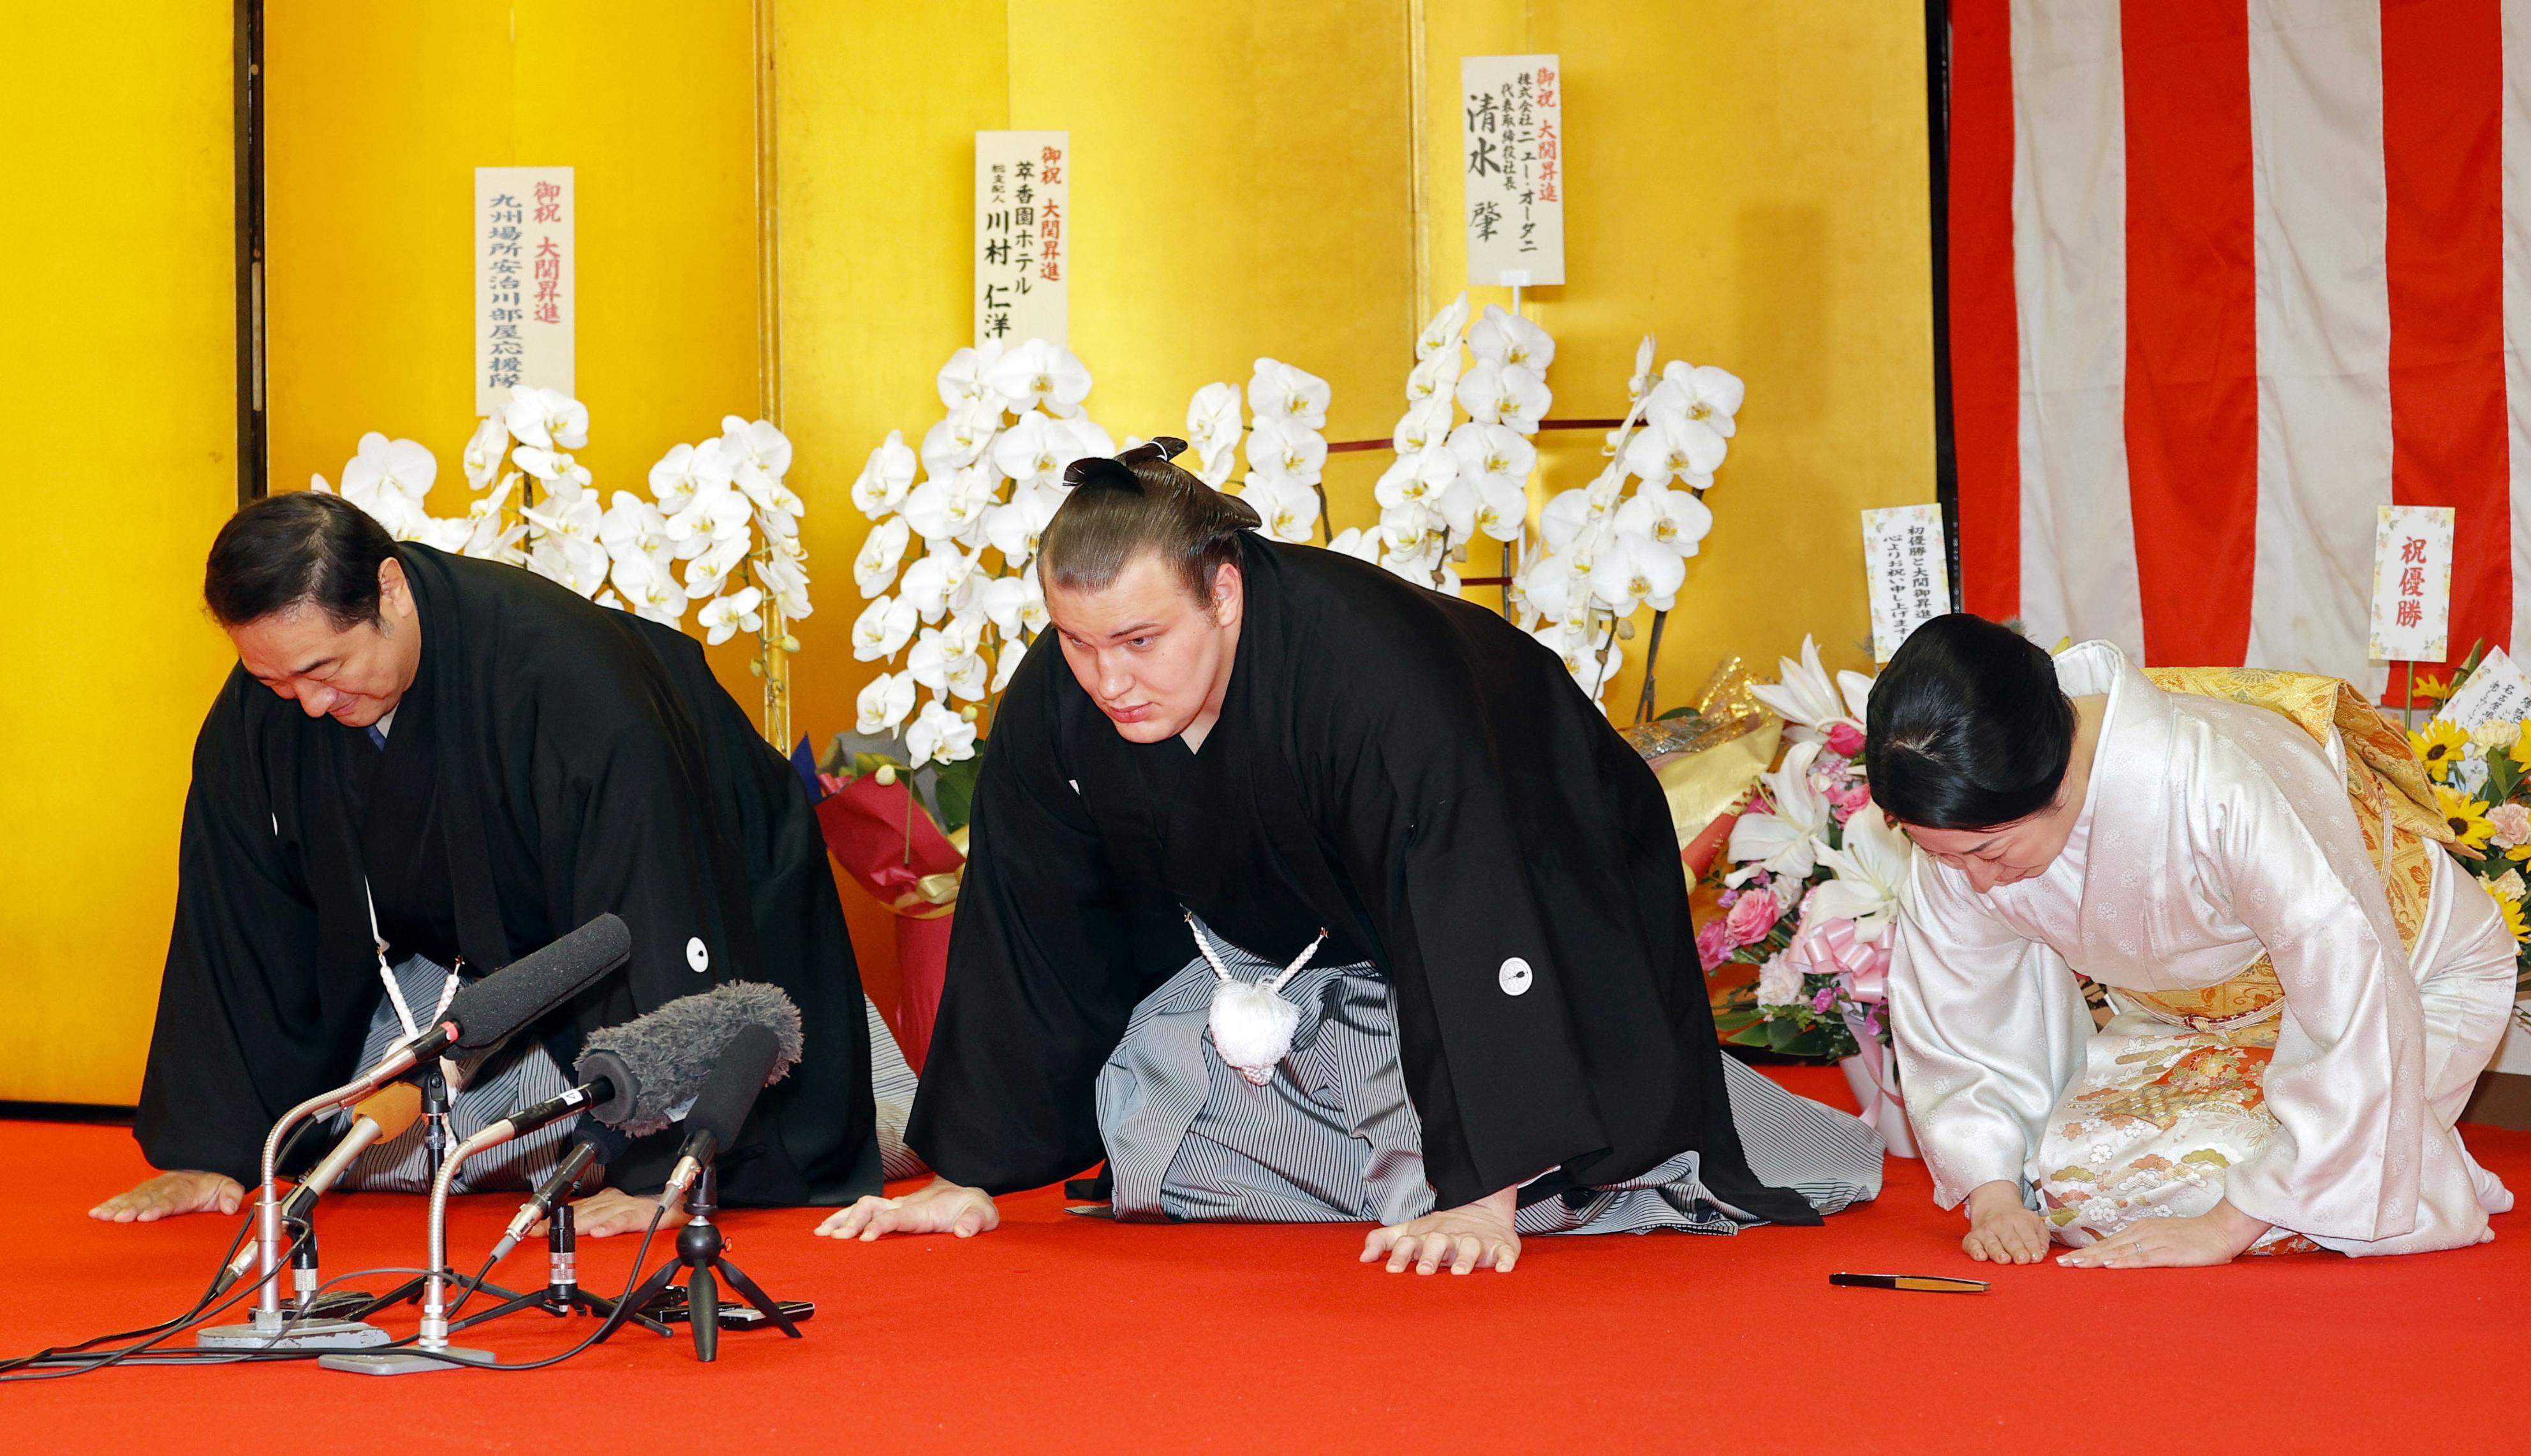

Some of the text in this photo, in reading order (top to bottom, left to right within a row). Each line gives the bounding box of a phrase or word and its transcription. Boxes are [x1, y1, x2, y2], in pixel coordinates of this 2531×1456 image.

[1467, 93, 1502, 242] 清水 肇
[1501, 83, 1517, 191] 代表取締役社長
[1537, 67, 1558, 202] 御祝 大関昇進
[534, 181, 561, 325] 御祝 大関昇進
[984, 210, 1012, 265] 川村
[1015, 161, 1035, 295] 萃香園ホテル
[1041, 146, 1061, 281] 御祝 大関昇進
[489, 194, 523, 388] 九州場所安治川部屋応援隊
[984, 284, 1012, 339] 仁洋
[1907, 526, 1932, 619] 初優勝と大関御昇進
[2396, 536, 2426, 628] 祝優勝
